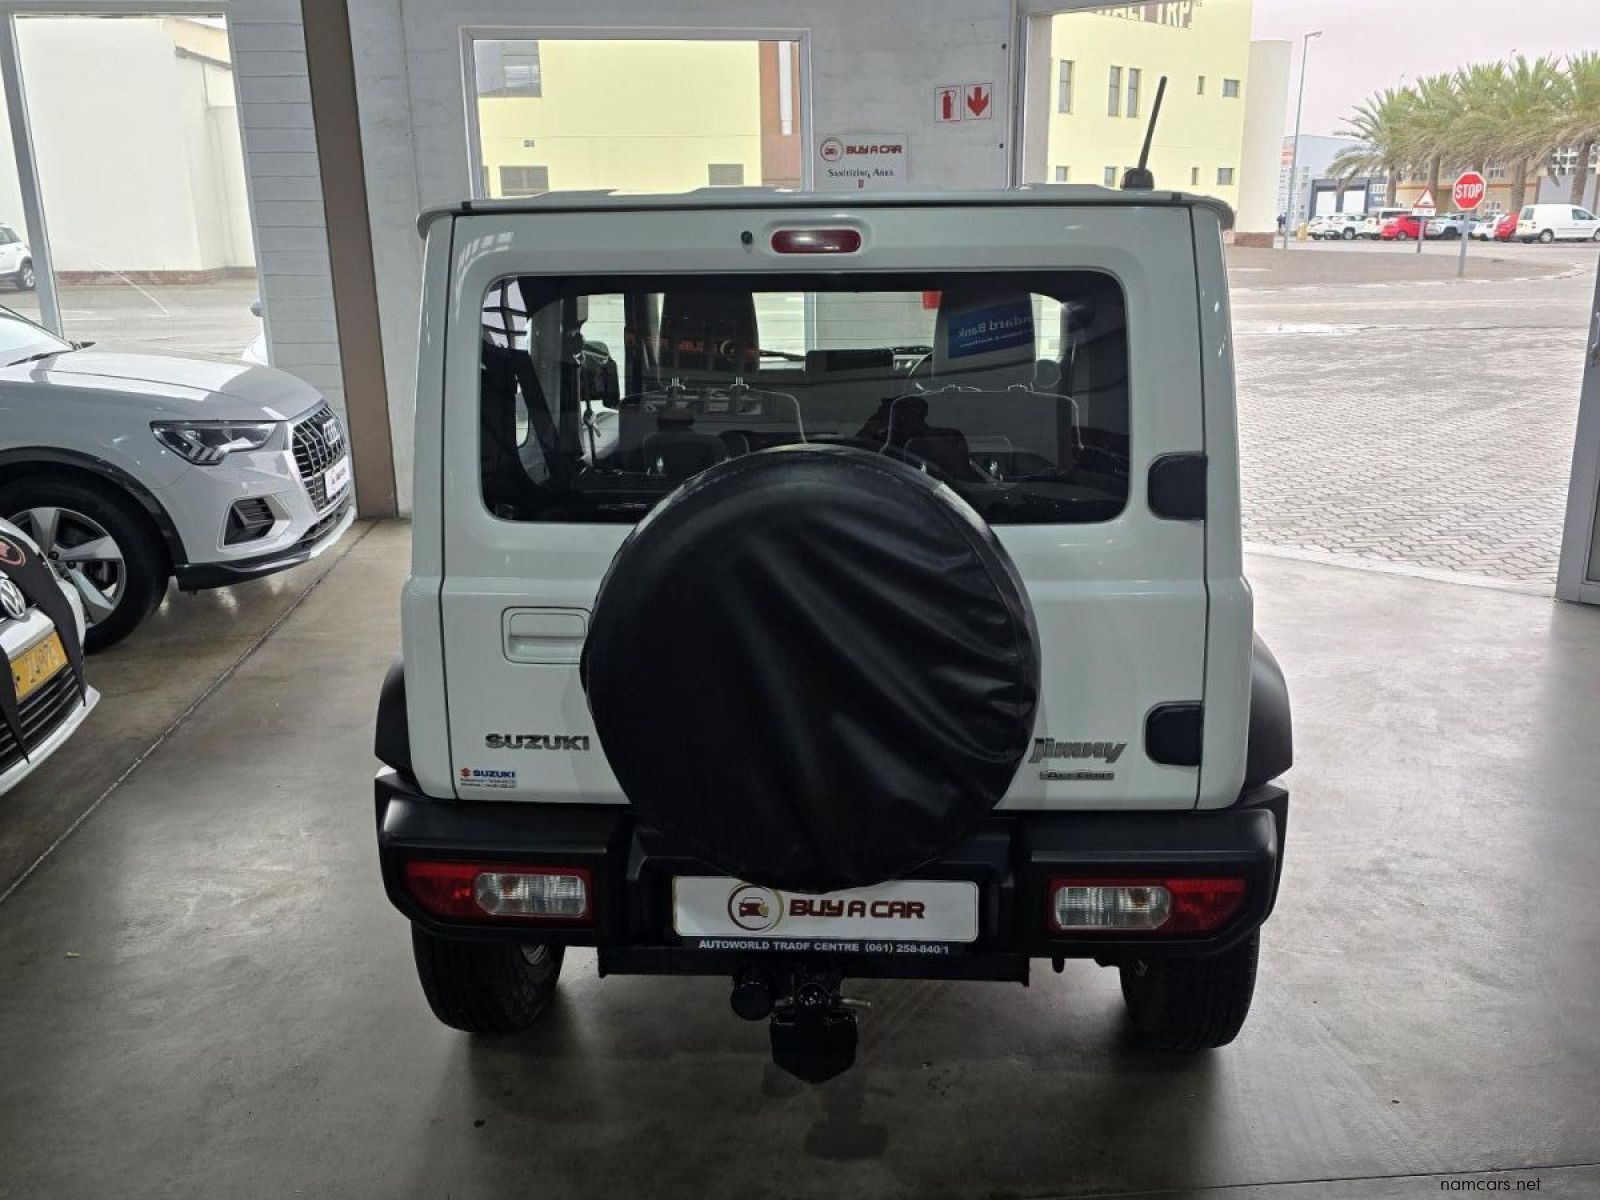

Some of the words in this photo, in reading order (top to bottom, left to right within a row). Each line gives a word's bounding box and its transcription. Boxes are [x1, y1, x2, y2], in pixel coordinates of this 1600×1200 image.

[845, 144, 869, 155] BUY
[870, 144, 879, 154] A
[879, 144, 903, 154] CAR
[1456, 183, 1482, 199] STOP
[485, 732, 590, 751] SUZUKI
[1028, 737, 1128, 764] Jimny
[473, 769, 515, 778] SUZUKI
[789, 899, 844, 917] BUY
[847, 900, 867, 918] A
[870, 900, 925, 919] CAR
[699, 940, 770, 950] AUTOWORLD
[814, 942, 860, 952] CENTRE
[865, 942, 893, 953] (061)
